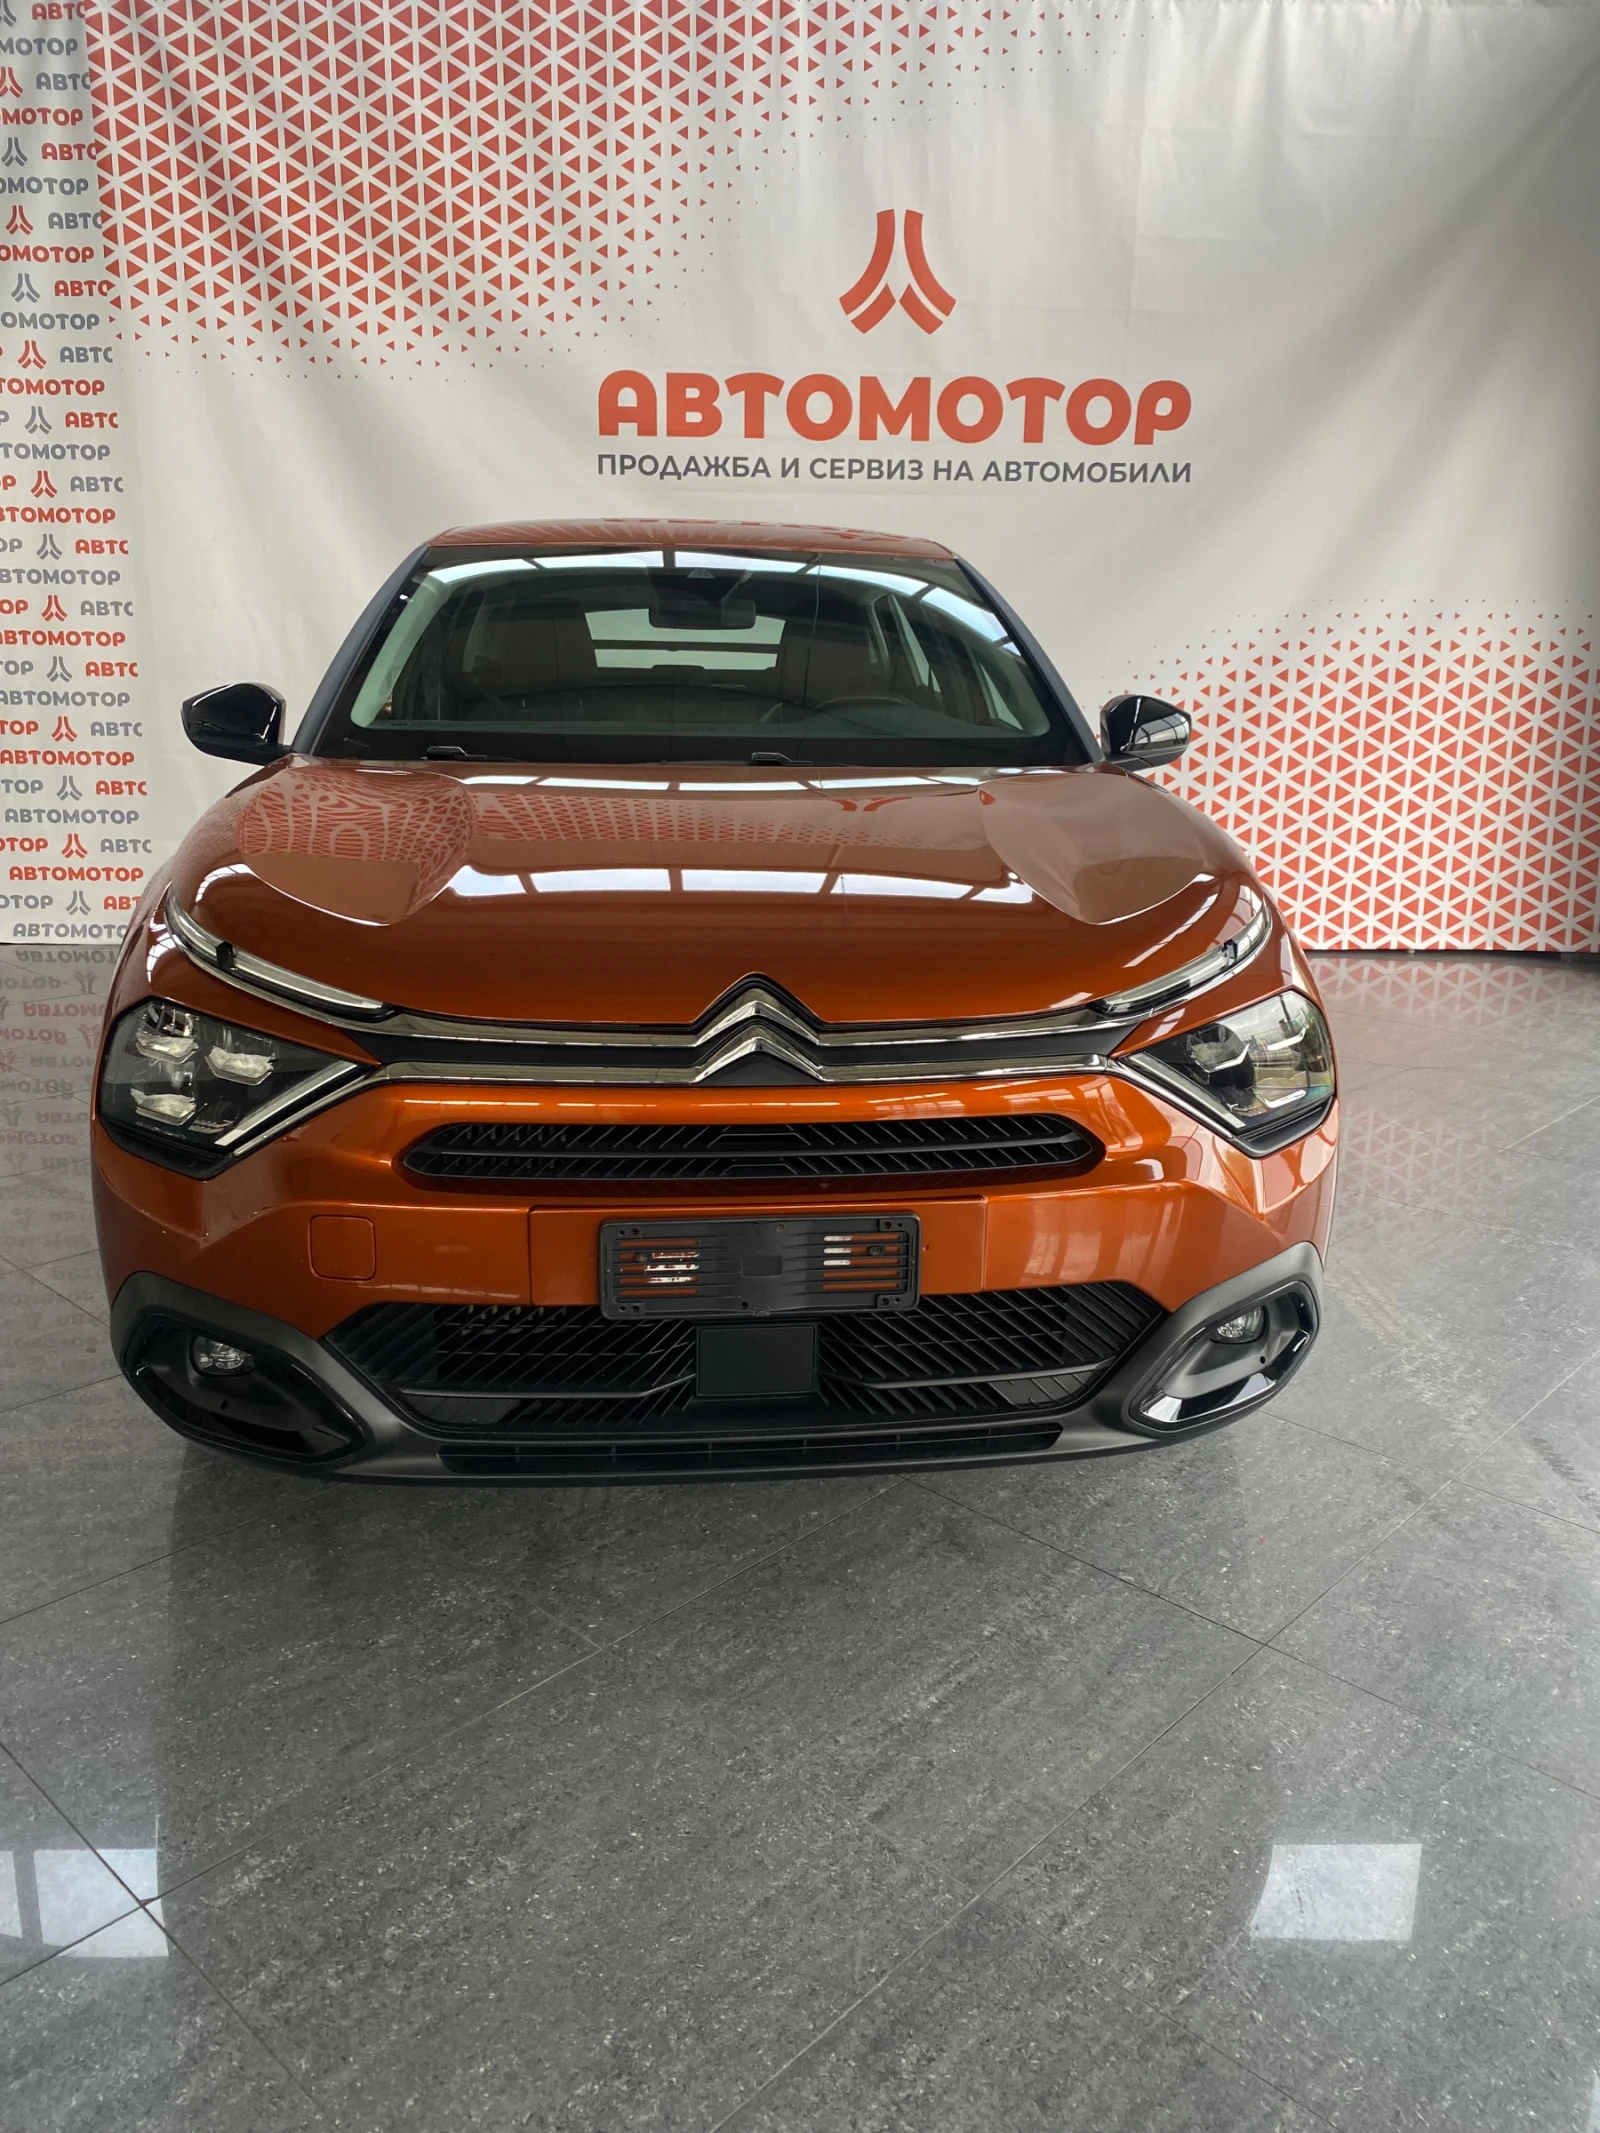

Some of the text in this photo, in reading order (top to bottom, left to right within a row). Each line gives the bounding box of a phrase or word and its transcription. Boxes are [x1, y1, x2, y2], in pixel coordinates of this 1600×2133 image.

[2, 108, 83, 126] МОТОР
[1, 312, 100, 330] ОМОТОР
[598, 369, 1192, 446] АВТОМОТОР
[597, 453, 1192, 484] ПРОДАЖБА И СЕРВИЗ НА АВТОМОБИЛИ
[0, 475, 17, 491] Р
[0, 630, 126, 647] ВТОМОТОР
[0, 660, 34, 675] ОР
[0, 750, 135, 766] АВТОМОТОР
[5, 809, 140, 824] АВТОМОТОР
[9, 866, 144, 882] АВТОМОТОР
